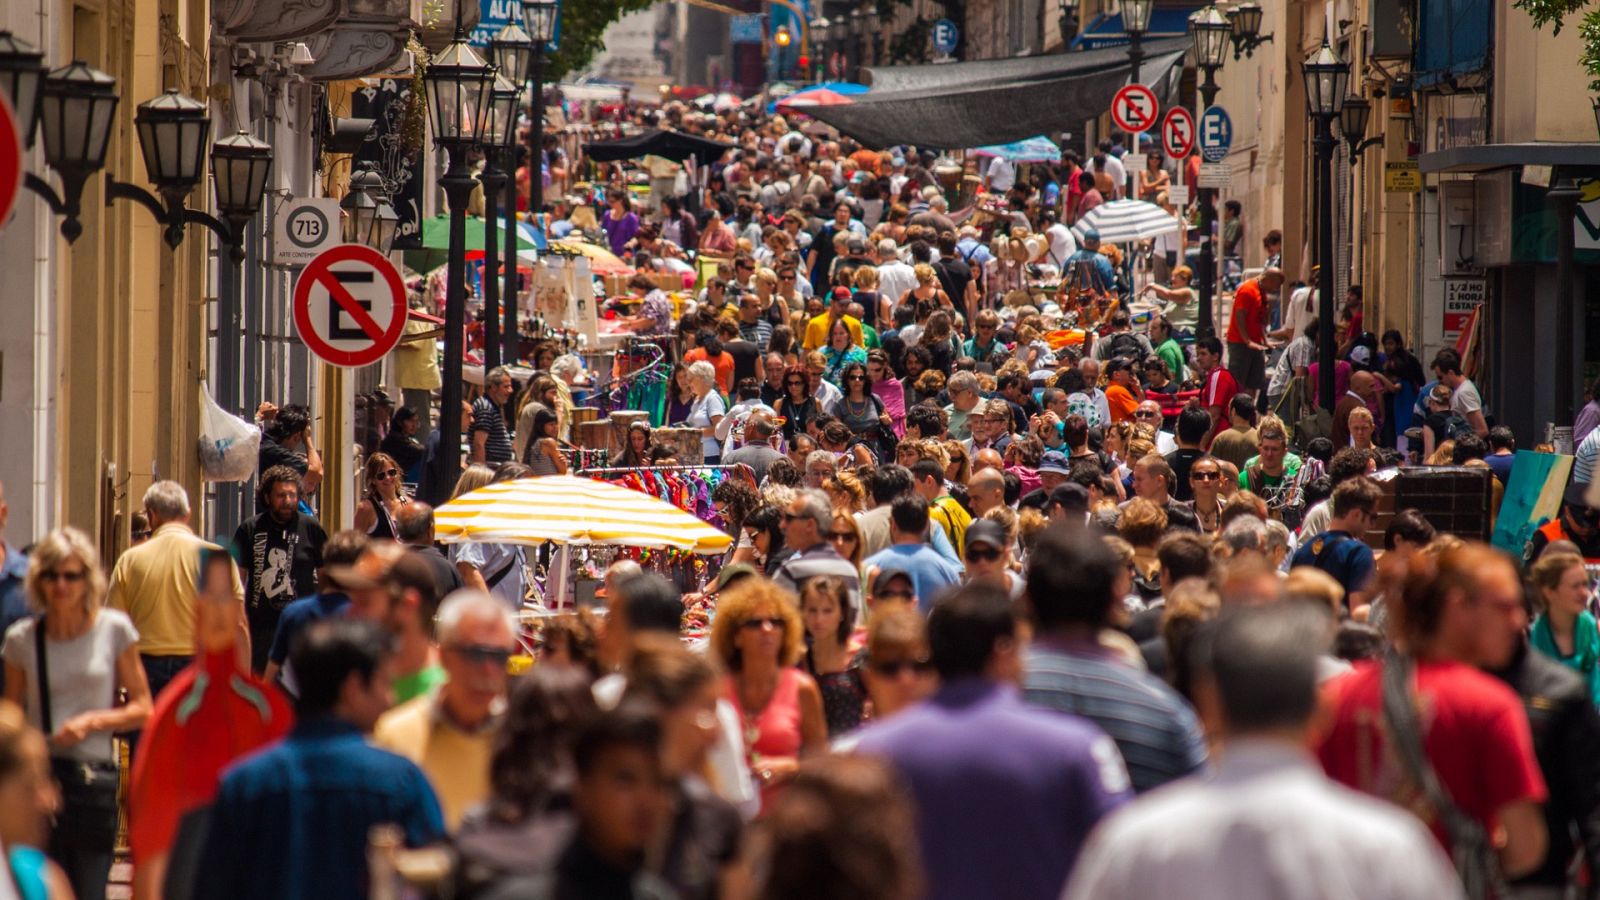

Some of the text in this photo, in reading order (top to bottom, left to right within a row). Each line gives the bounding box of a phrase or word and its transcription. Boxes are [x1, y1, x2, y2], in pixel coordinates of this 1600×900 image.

[937, 25, 948, 45] E
[1126, 95, 1144, 122] E
[1172, 118, 1184, 148] E
[1204, 115, 1220, 146] E
[296, 220, 320, 236] 713
[1449, 283, 1468, 292] 1/2
[329, 271, 374, 340] E
